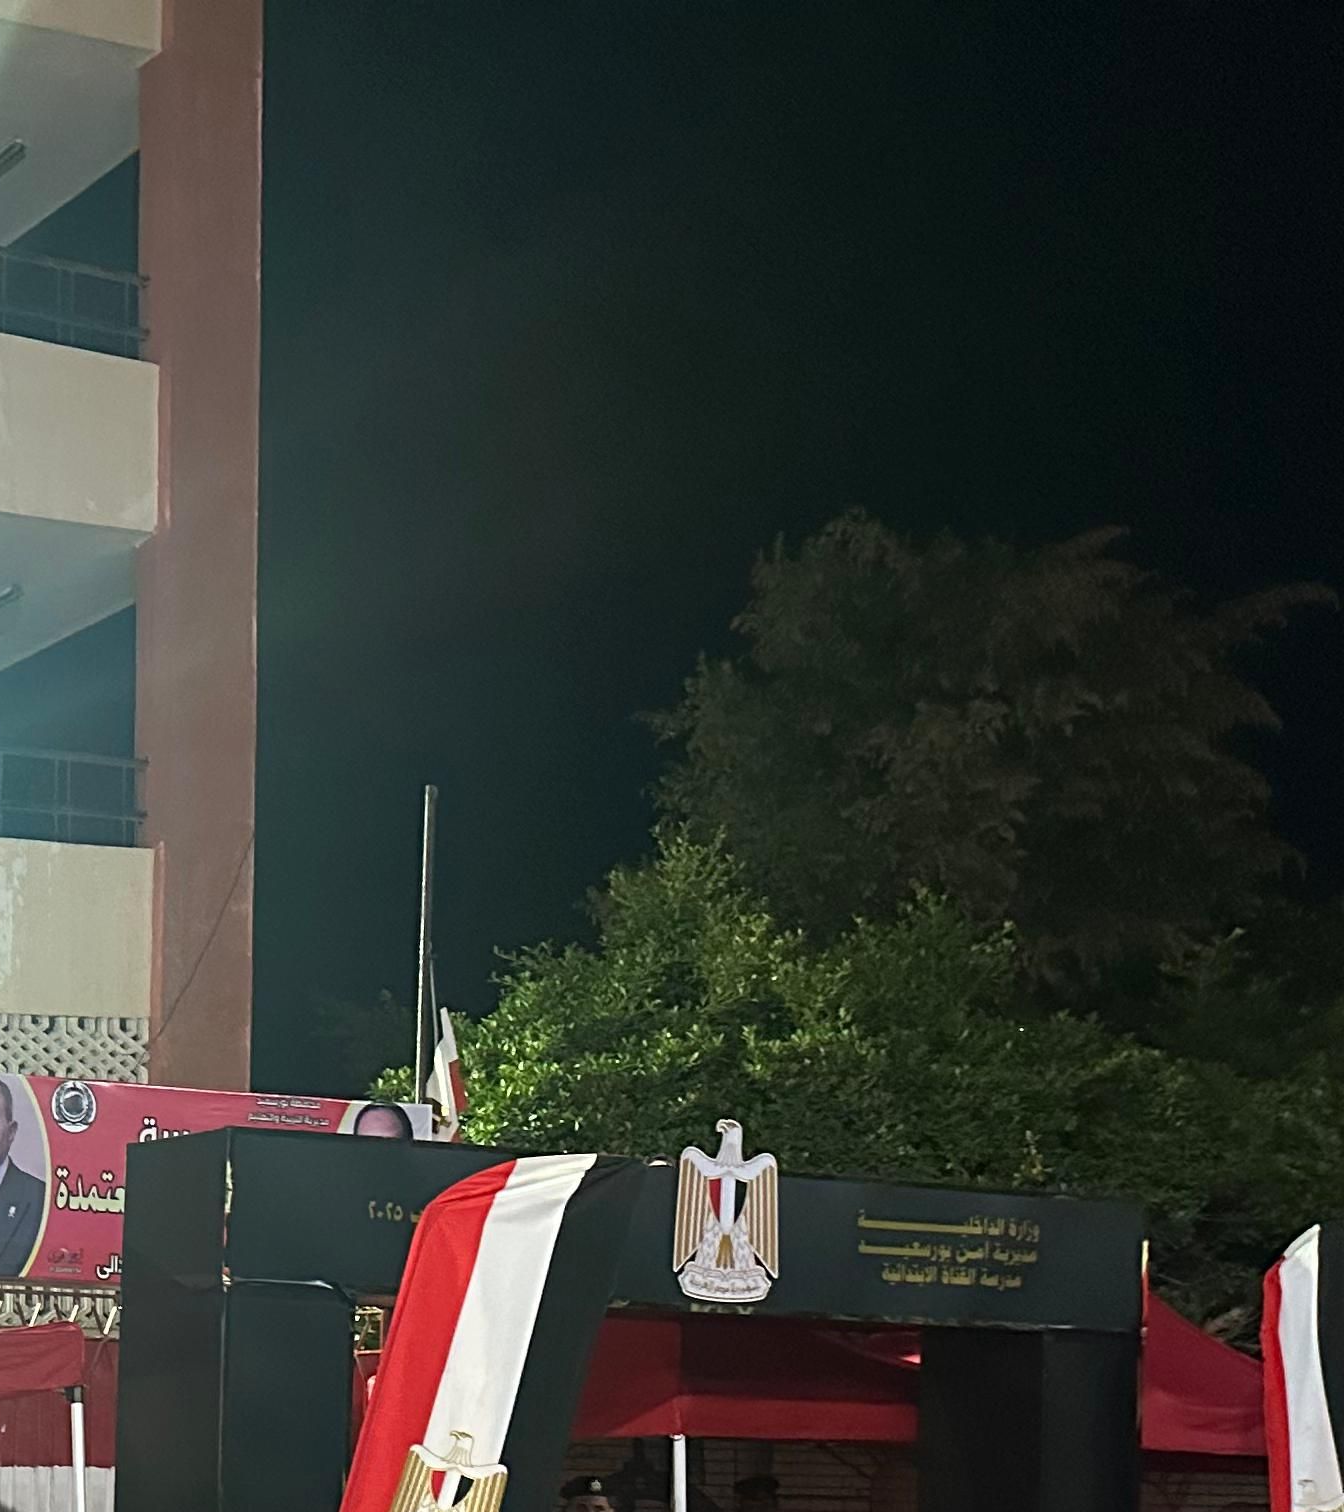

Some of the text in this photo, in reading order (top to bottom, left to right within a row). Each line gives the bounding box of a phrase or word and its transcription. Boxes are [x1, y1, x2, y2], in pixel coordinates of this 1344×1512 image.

[55, 1165, 125, 1213] عتمدة
[368, 1200, 404, 1222] ٢٠٢٥
[979, 1266, 1023, 1292] مدرسة
